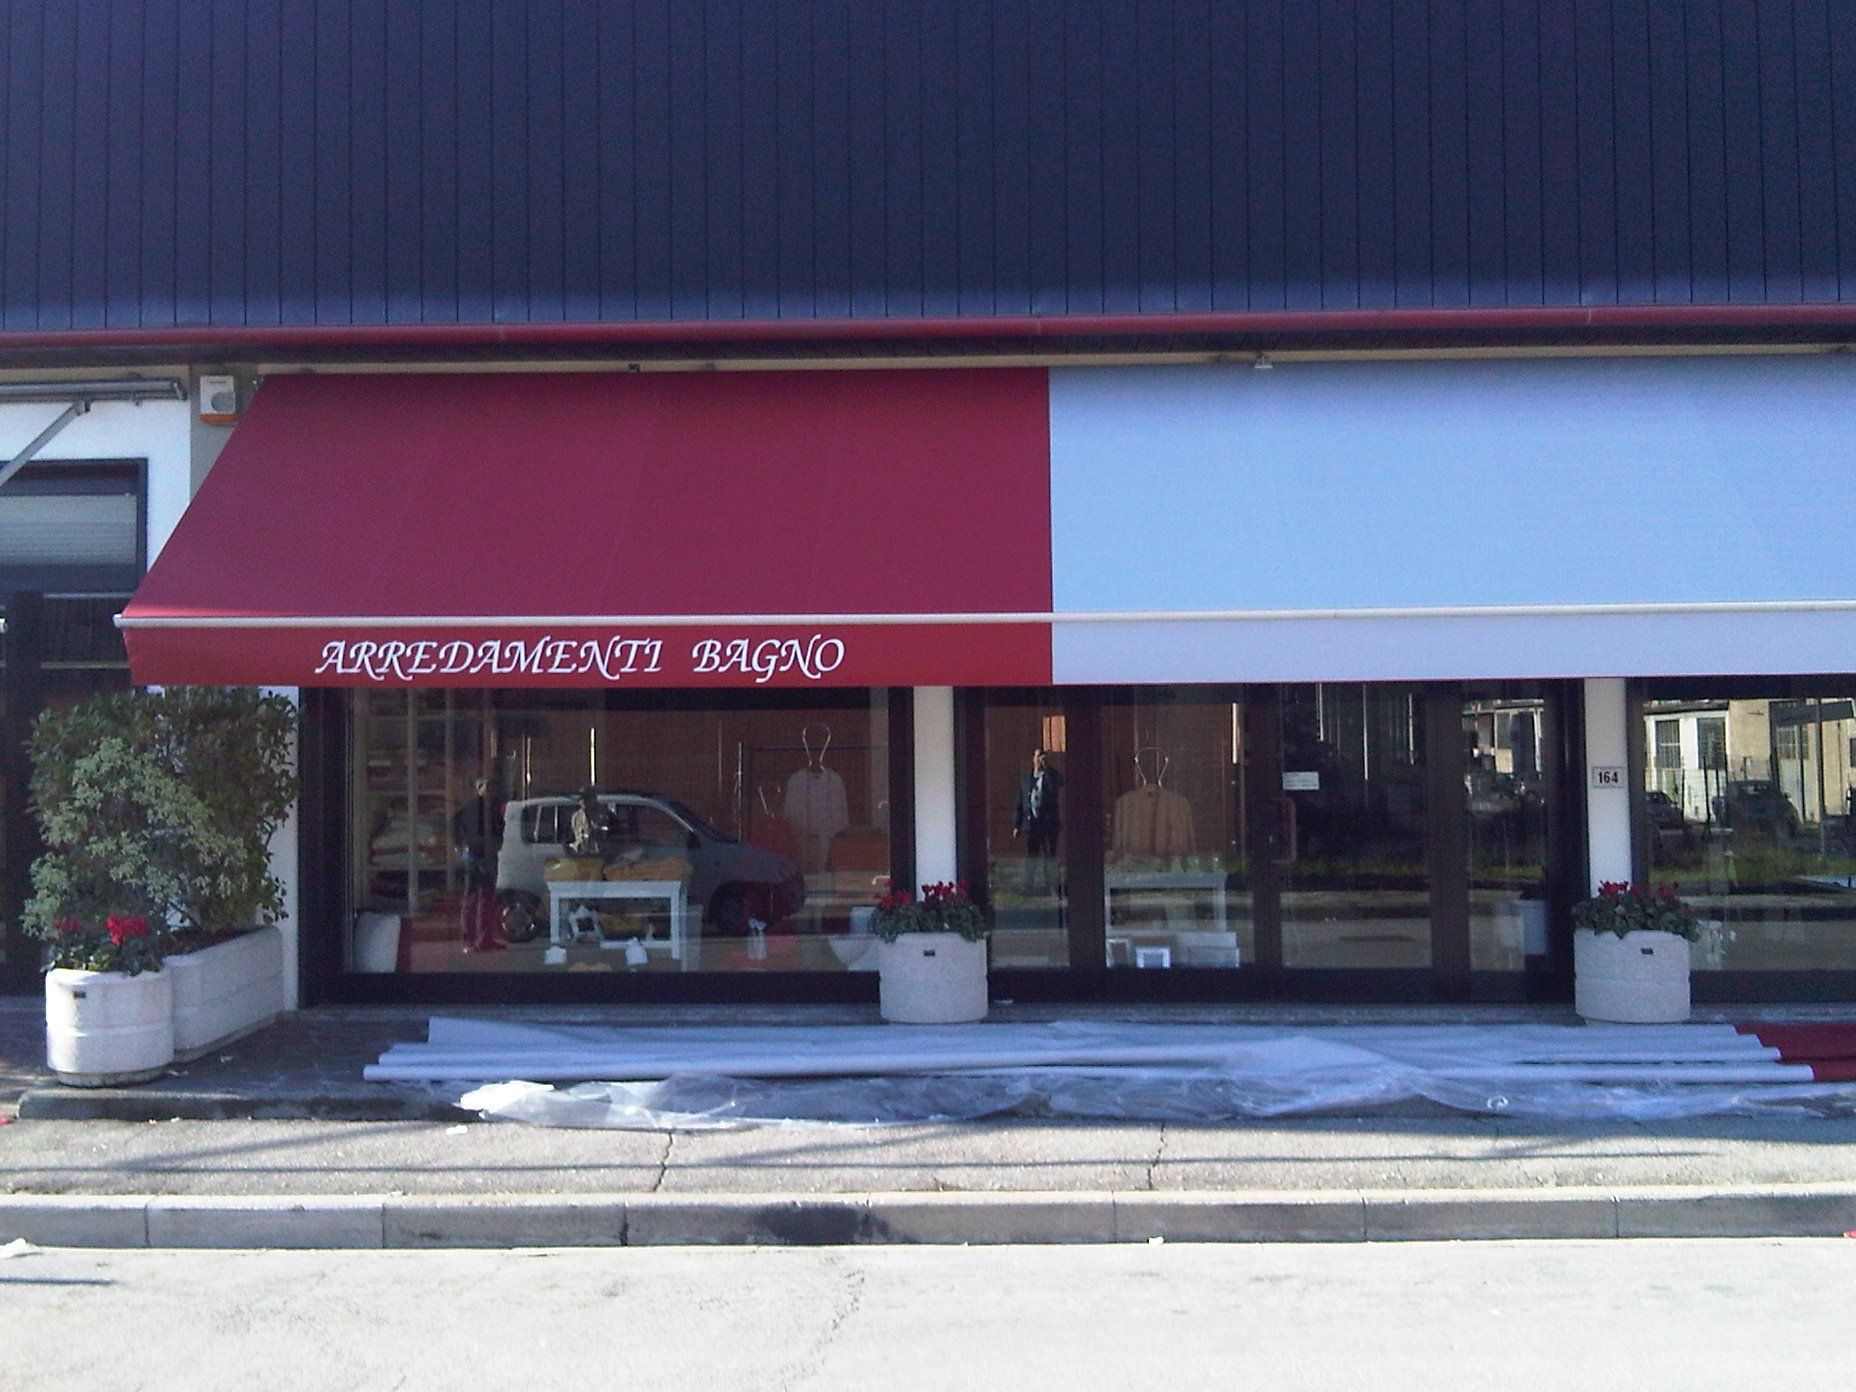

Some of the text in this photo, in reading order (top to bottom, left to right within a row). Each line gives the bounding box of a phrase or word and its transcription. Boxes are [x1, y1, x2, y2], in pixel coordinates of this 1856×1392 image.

[314, 634, 846, 684] ARREDAMENTI BAGNO
[1598, 771, 1618, 784] 164
